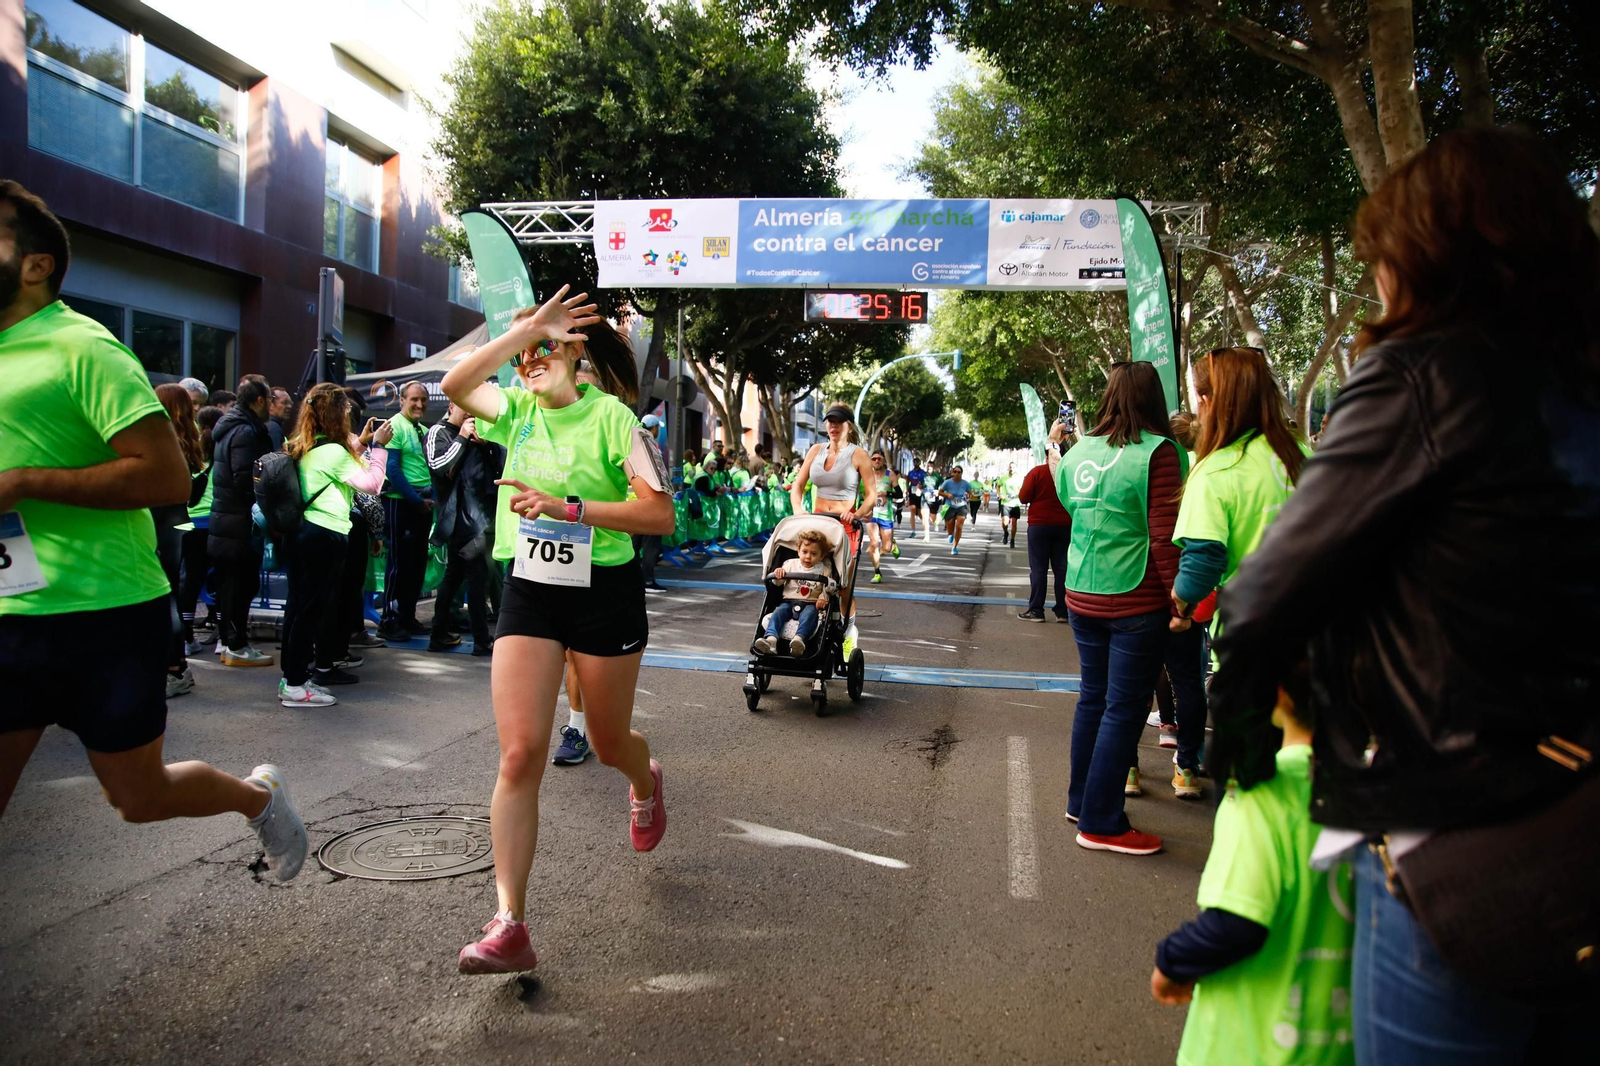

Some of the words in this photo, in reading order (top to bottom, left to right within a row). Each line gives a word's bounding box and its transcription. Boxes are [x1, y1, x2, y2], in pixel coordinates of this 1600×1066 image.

[753, 207, 842, 227] Almería
[849, 211, 877, 226] en
[886, 208, 974, 227] marcha
[1019, 211, 1066, 224] cajamar
[752, 236, 827, 253] contra
[833, 233, 855, 253] el
[863, 233, 943, 253] cáncer
[1061, 238, 1116, 250] Fundación
[600, 253, 632, 262] ALMERÍA
[1089, 257, 1108, 267] Ejido
[1021, 262, 1045, 270] Toyota
[526, 537, 575, 565] 705
